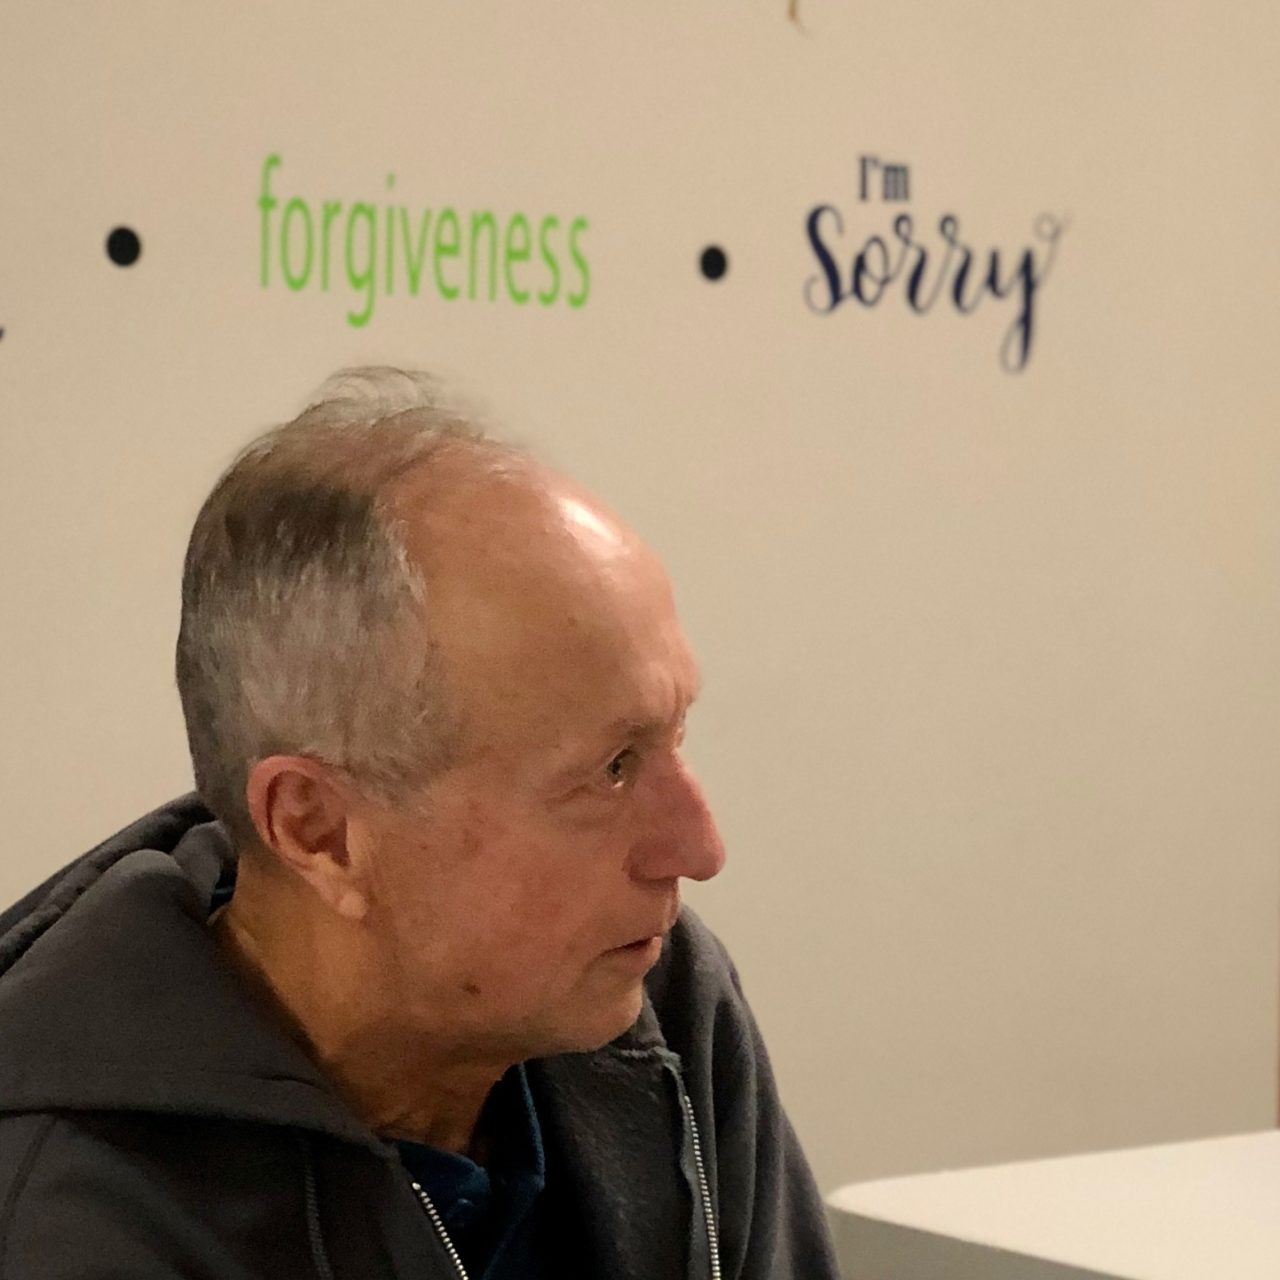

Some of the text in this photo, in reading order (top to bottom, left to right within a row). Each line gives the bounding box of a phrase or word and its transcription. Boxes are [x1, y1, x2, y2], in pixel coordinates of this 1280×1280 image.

[258, 153, 592, 328] forgiveness
[858, 154, 911, 202] I'm
[803, 204, 1070, 374] Sorry
